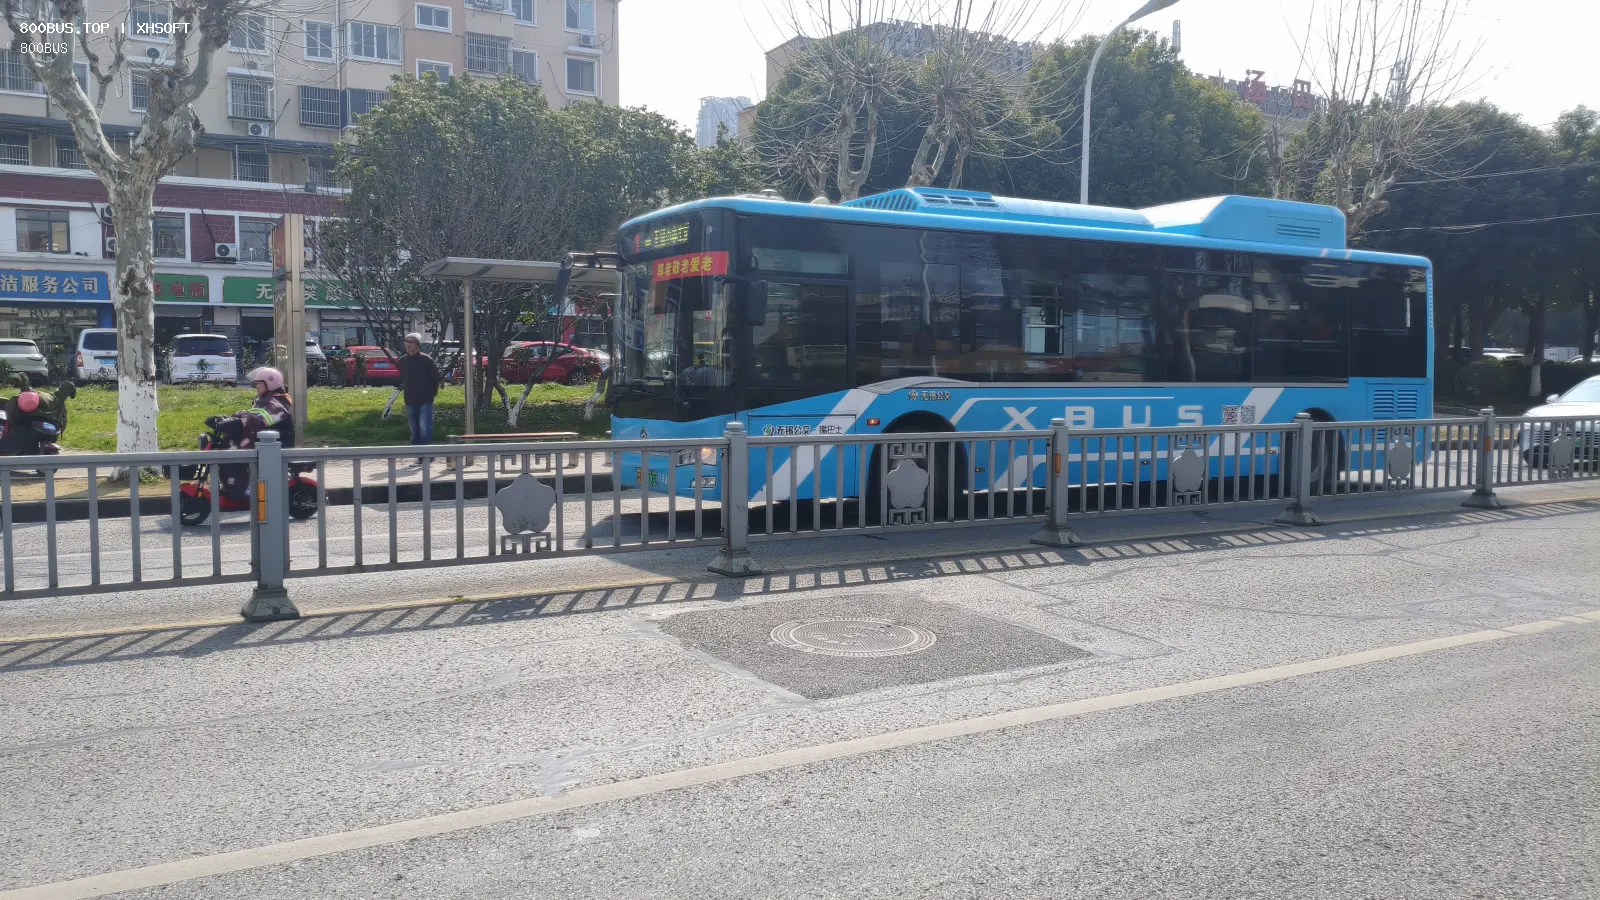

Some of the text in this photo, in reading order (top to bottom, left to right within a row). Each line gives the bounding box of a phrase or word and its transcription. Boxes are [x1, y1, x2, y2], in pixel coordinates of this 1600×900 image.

[657, 256, 713, 277] 尊老敬老爱老
[0, 274, 99, 294] 洁服务公司
[1002, 405, 1203, 431] XBUS
